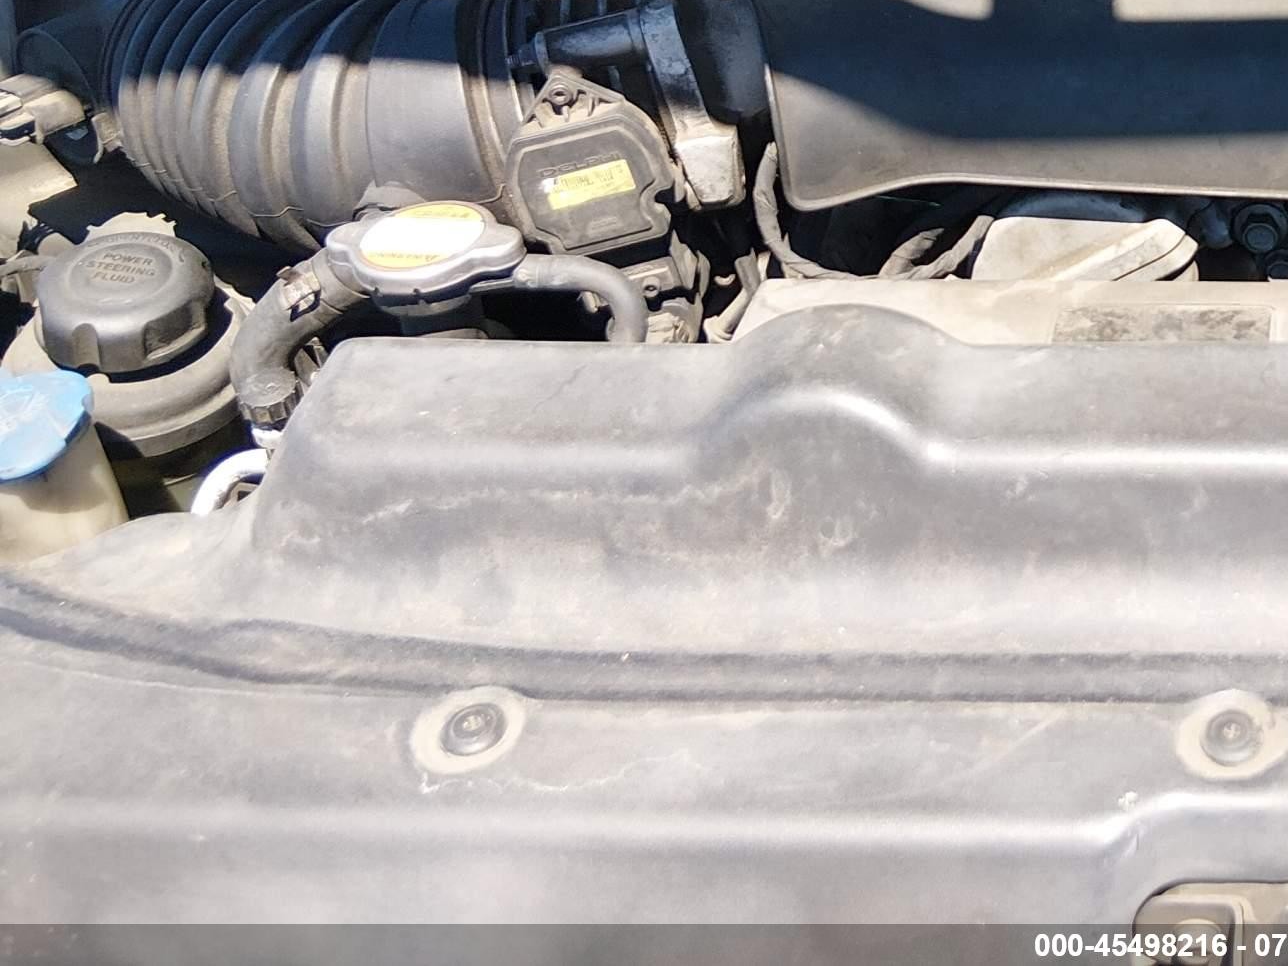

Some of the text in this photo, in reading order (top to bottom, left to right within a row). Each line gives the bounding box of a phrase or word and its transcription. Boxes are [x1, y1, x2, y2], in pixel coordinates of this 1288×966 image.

[103, 251, 154, 267] POWER
[85, 259, 157, 277] STEERING
[92, 271, 136, 284] FLUID
